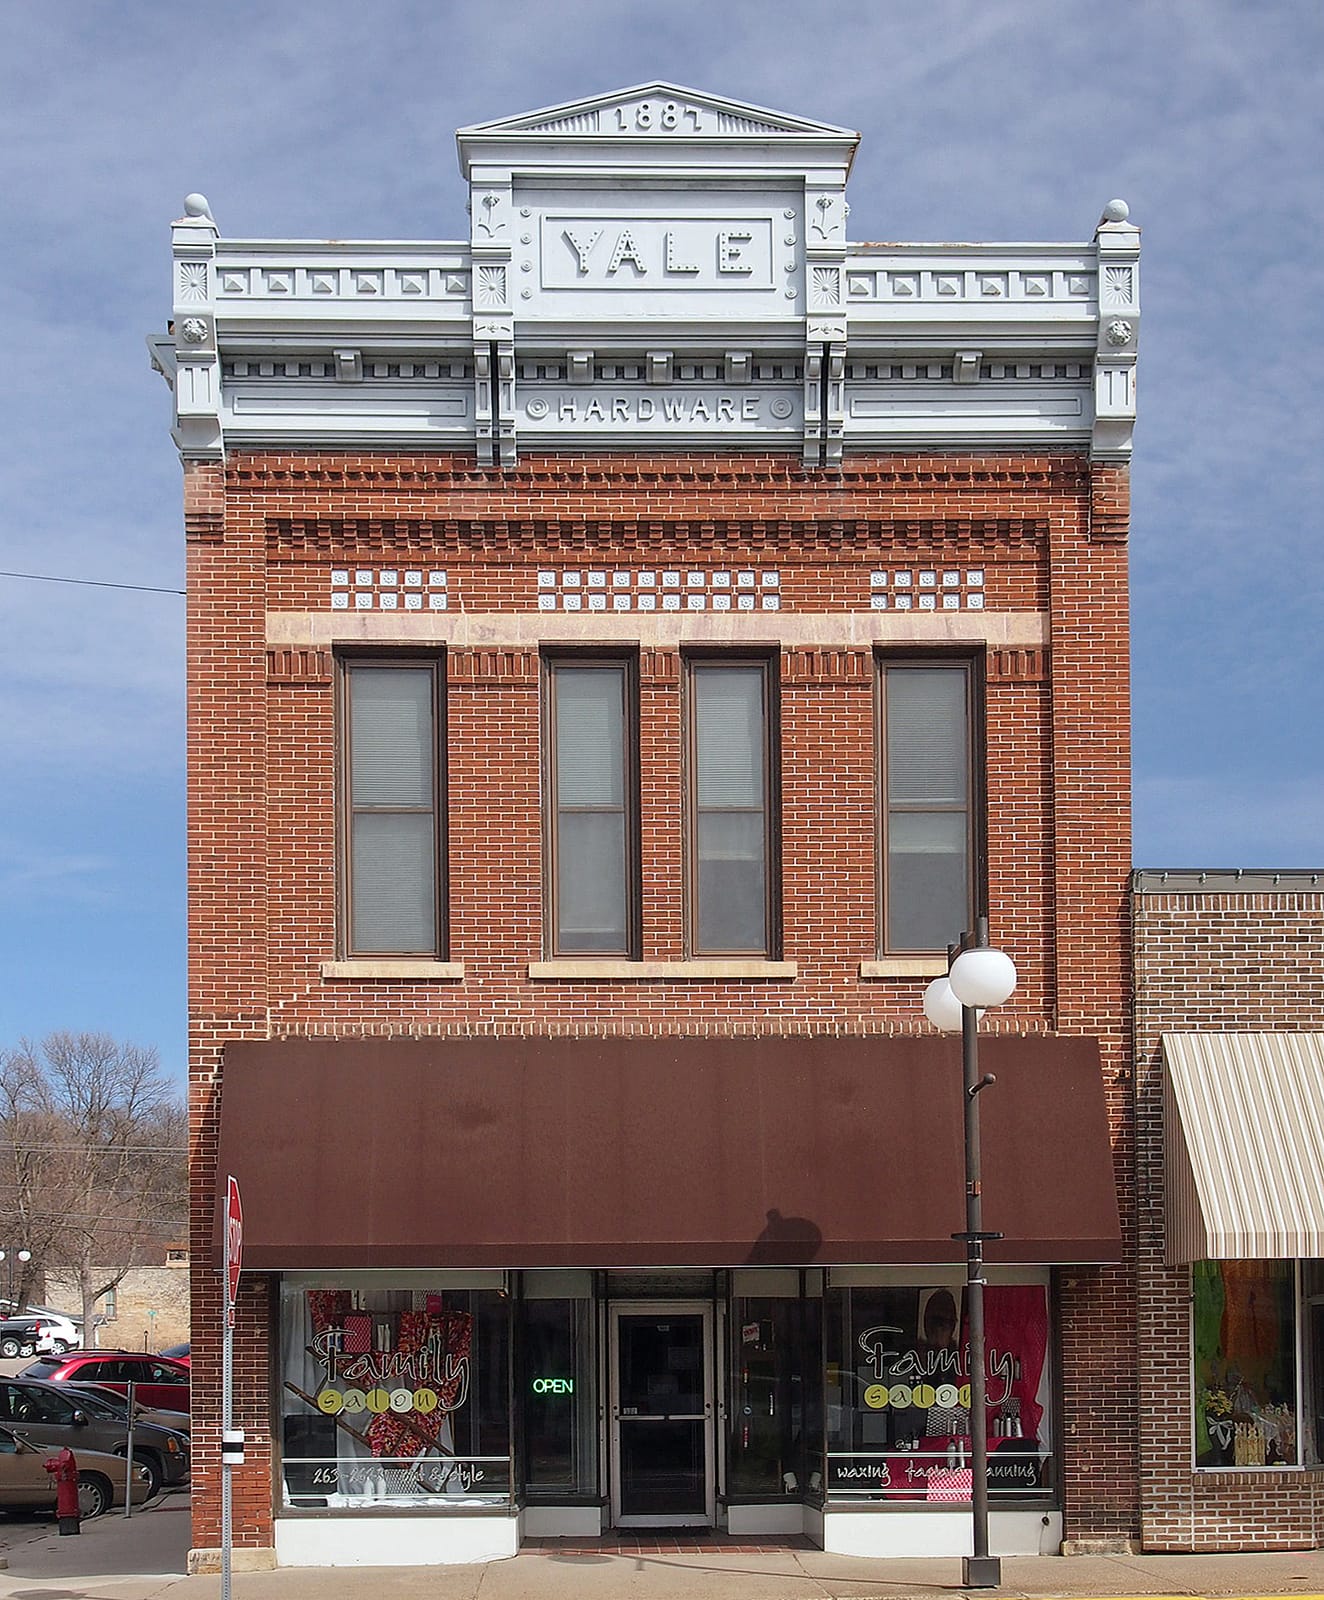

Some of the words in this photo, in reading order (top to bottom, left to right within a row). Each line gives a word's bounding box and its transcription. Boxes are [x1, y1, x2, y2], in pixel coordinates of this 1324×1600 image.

[614, 103, 704, 132] 1887
[562, 228, 753, 274] YALE
[557, 395, 761, 422] HARDWARE
[311, 1327, 471, 1412] Family
[858, 1325, 1014, 1406] Famiy
[321, 1388, 433, 1412] salon
[532, 1378, 573, 1394] OPEN
[449, 1463, 485, 1491] style
[837, 1462, 892, 1487] waxing
[985, 1461, 1037, 1487] anning
